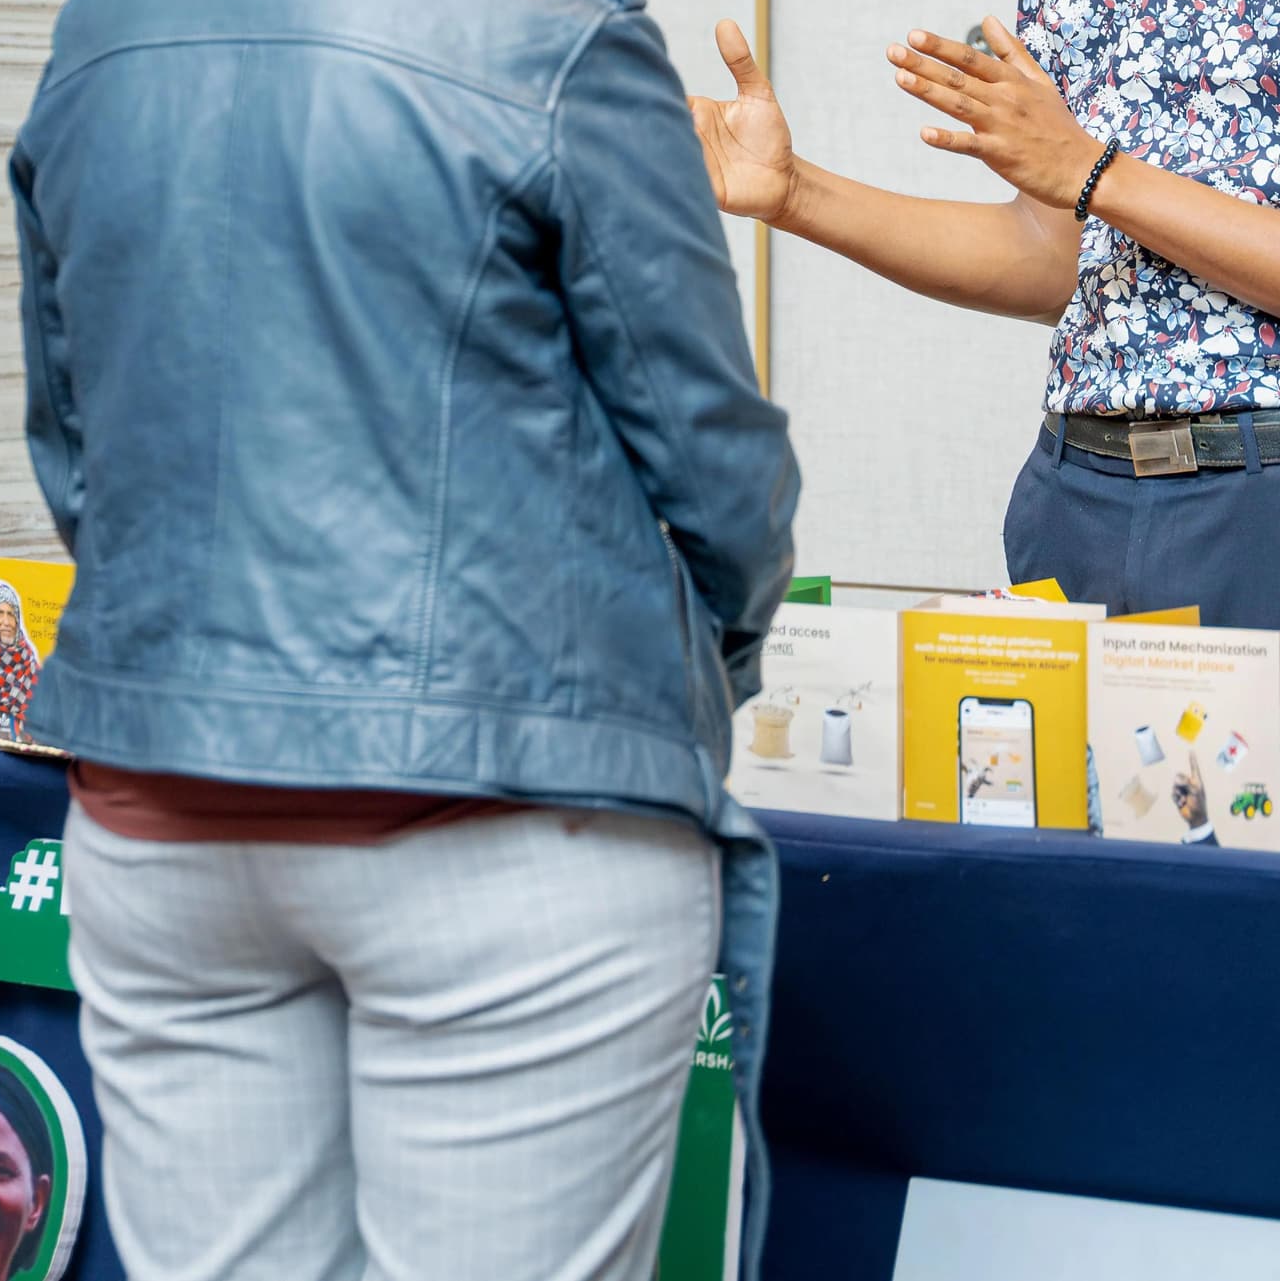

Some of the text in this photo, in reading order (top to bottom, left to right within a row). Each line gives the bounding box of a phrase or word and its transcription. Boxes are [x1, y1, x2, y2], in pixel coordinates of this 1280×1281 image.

[789, 628, 830, 640] access
[1103, 636, 1267, 657] Input and Mechanization
[1103, 654, 1234, 674] Digital Market place
